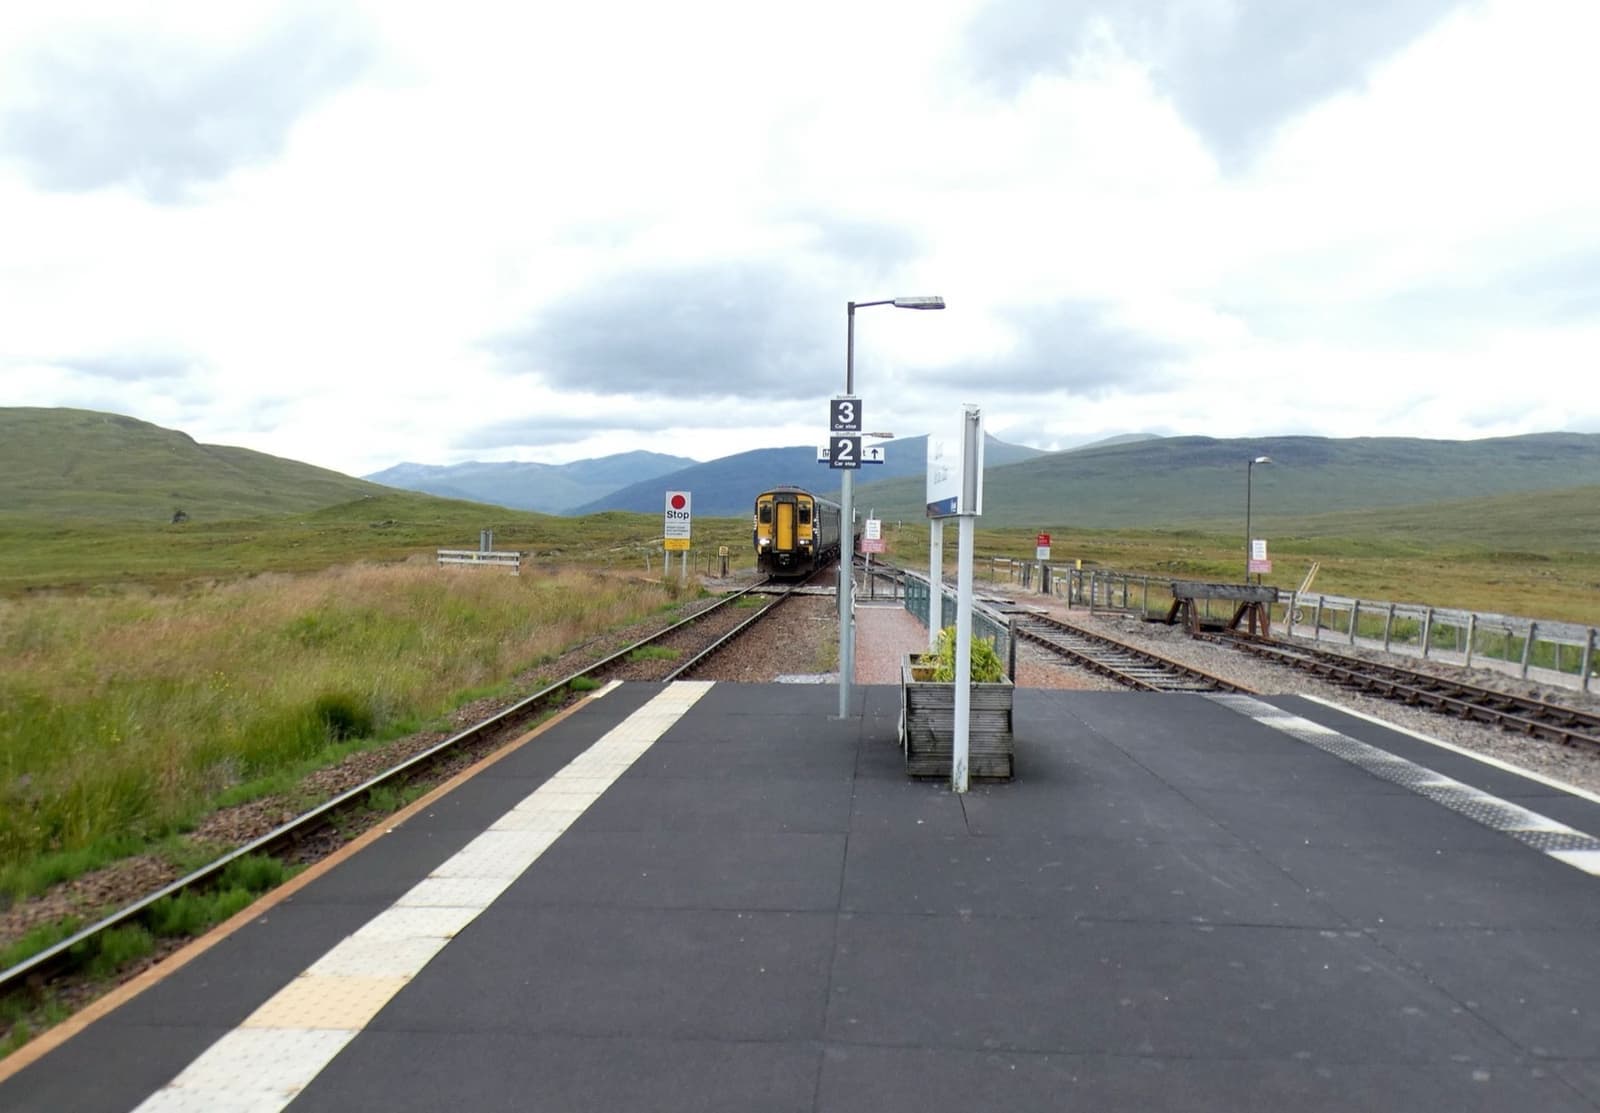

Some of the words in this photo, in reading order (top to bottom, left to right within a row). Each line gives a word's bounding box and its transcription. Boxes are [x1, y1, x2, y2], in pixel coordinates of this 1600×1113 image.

[838, 402, 854, 423] 3
[838, 439, 853, 460] 2
[666, 510, 690, 520] Stop
